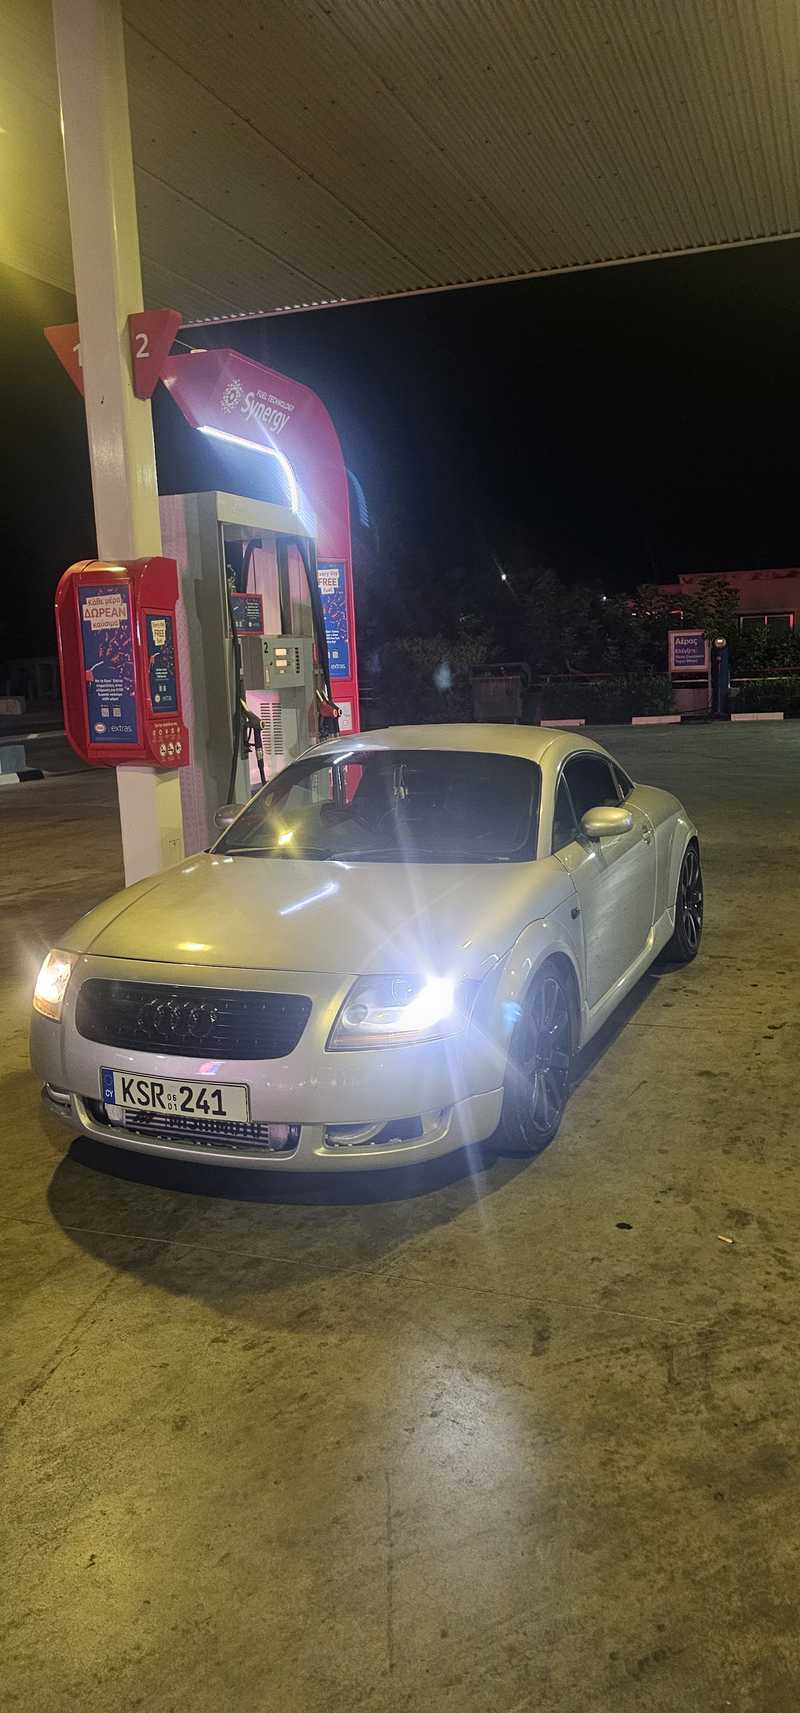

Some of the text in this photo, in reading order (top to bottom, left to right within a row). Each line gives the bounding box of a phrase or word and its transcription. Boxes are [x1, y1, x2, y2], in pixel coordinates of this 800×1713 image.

[136, 333, 150, 358] 2
[241, 391, 290, 434] Synergy
[319, 578, 337, 586] FREE
[85, 607, 126, 618] ΔΩΡΕΑΝ
[264, 642, 269, 654] 2
[105, 1089, 114, 1097] CY
[121, 1077, 166, 1109] KSR
[179, 1086, 226, 1116] 241
[167, 1103, 178, 1111] 01
